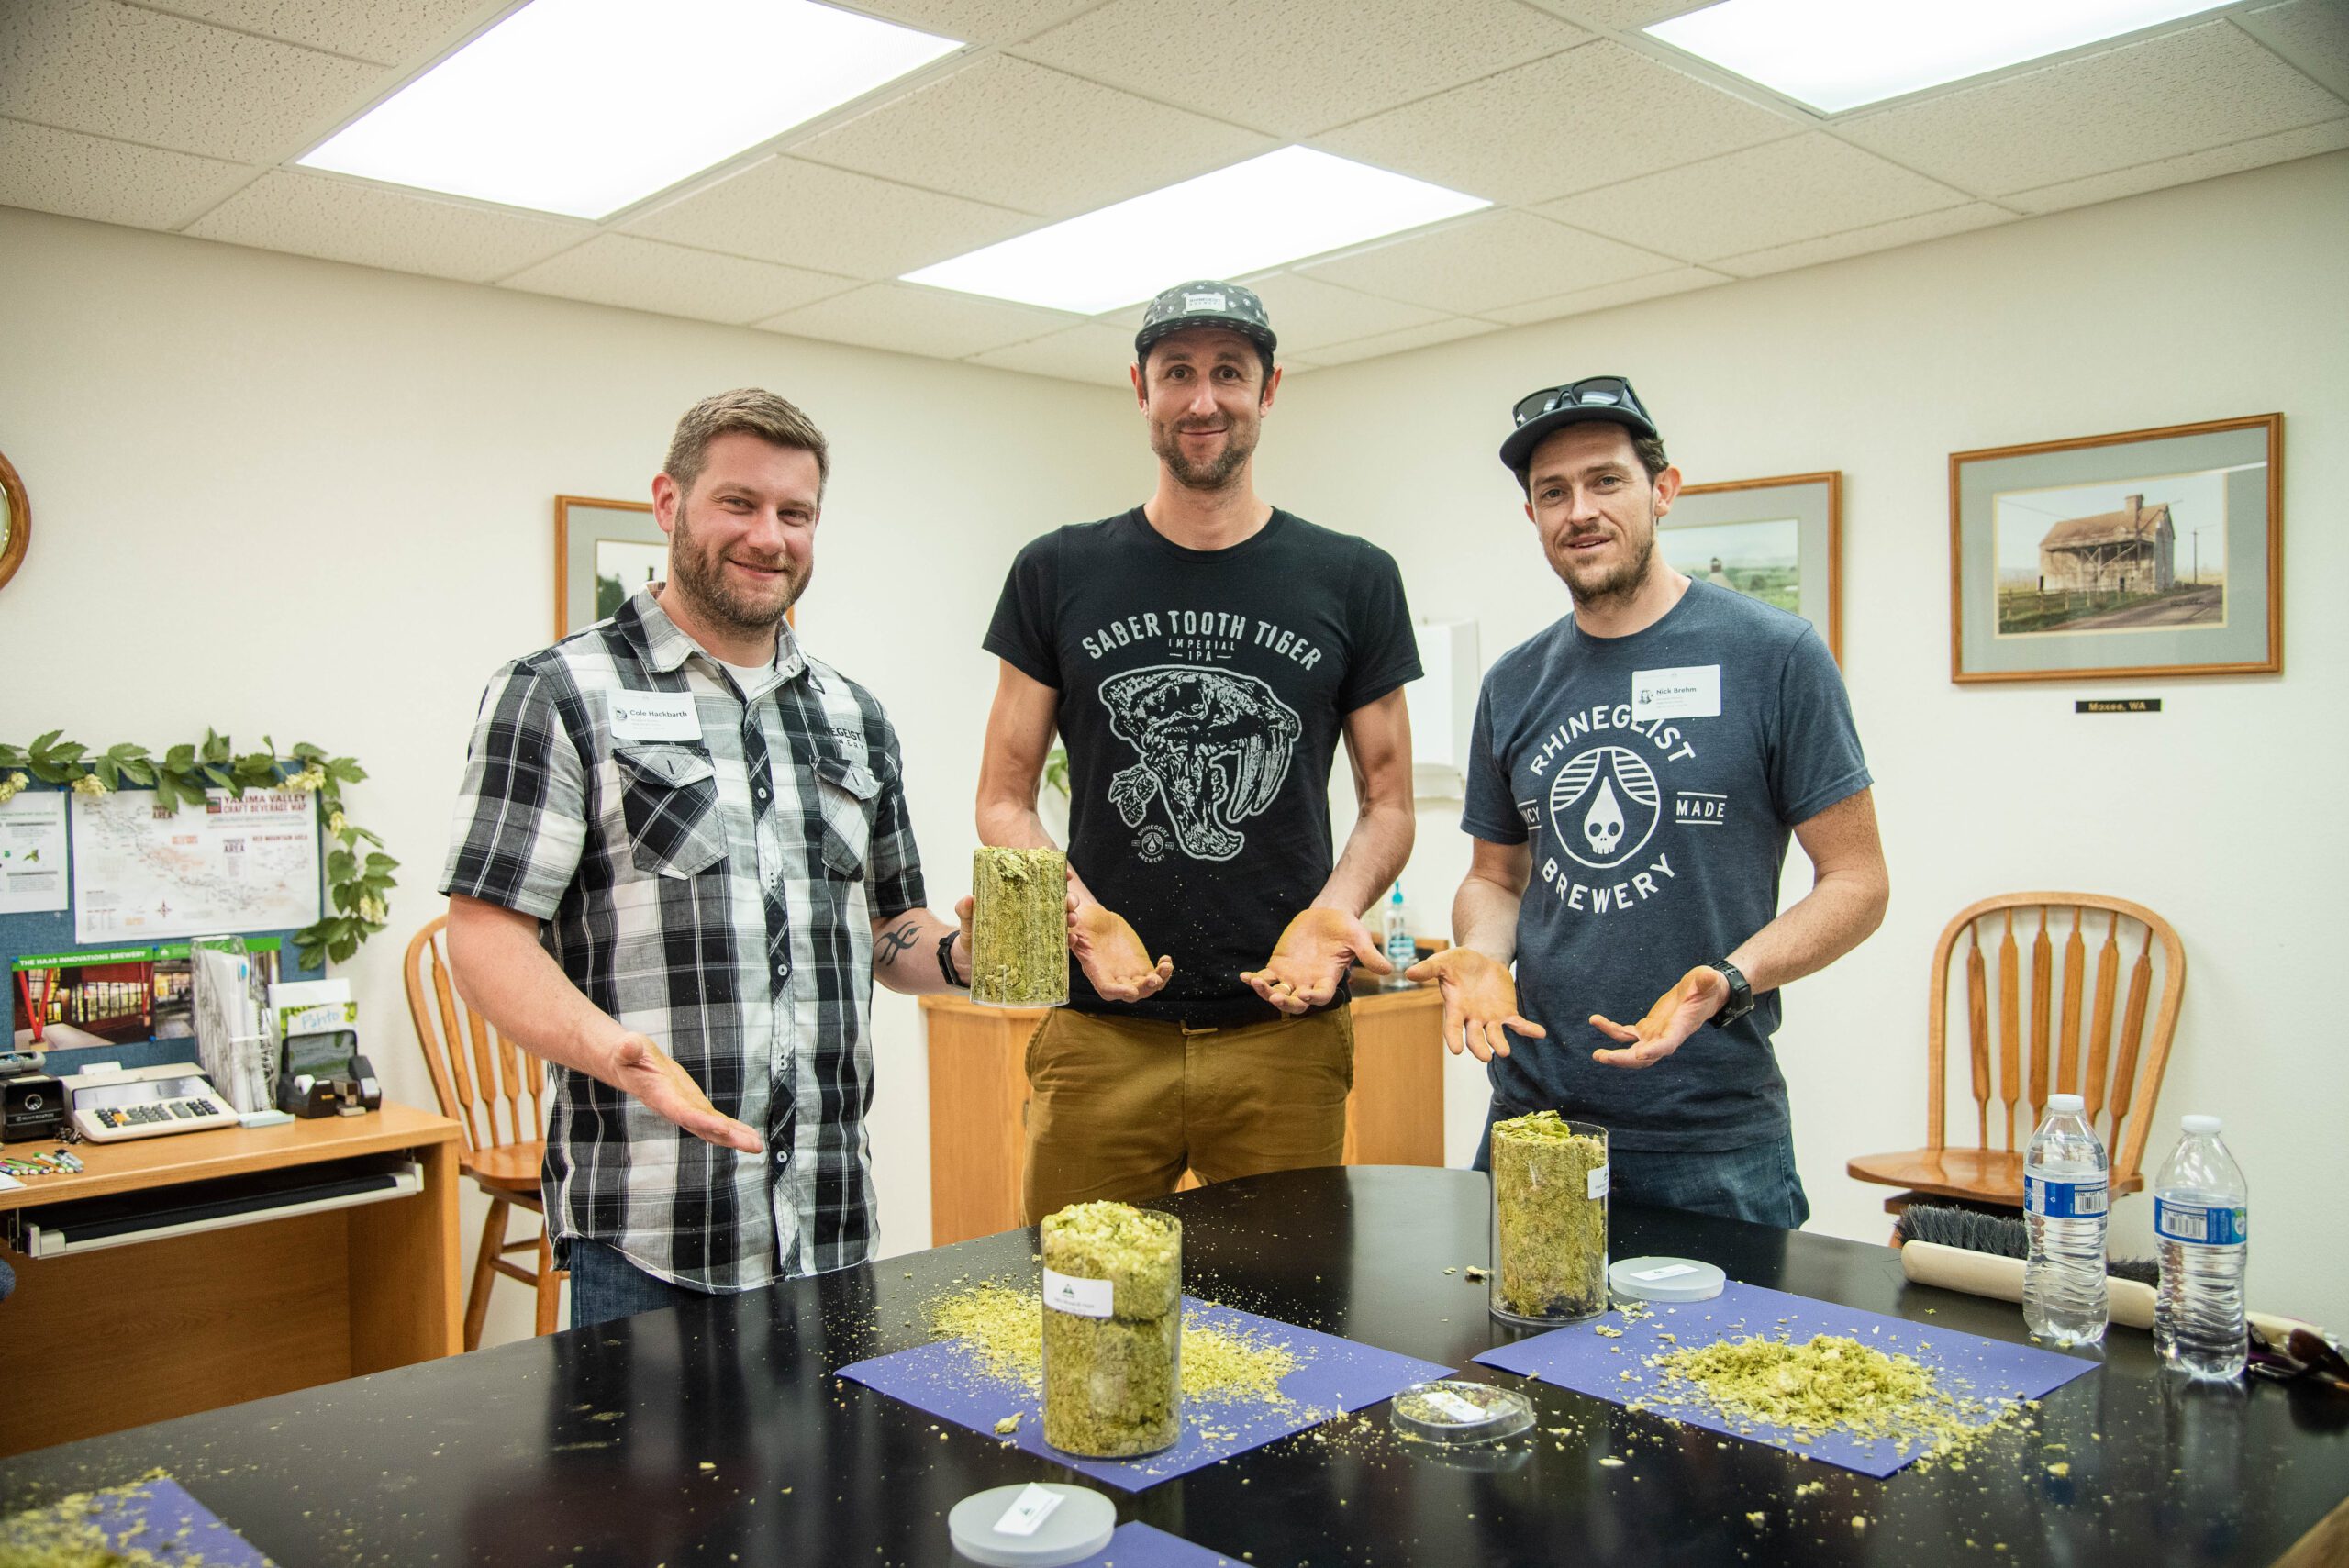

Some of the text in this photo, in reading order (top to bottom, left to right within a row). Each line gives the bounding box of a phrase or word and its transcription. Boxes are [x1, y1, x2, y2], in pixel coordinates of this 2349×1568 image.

[1082, 610, 1323, 672] SABER TOOTH TIGER
[1168, 638, 1236, 651] IMPERIAL
[1188, 651, 1212, 662] IPA
[2128, 701, 2147, 711] WA
[223, 794, 306, 804] YAIMA VALLEY
[223, 804, 248, 814] CRAFT
[1675, 799, 1726, 818] MADE
[1137, 851, 1165, 863] BREWERY
[1542, 852, 1676, 915] BREWERY
[20, 951, 147, 967] THE HAAS INNOVATIONS BREWERY
